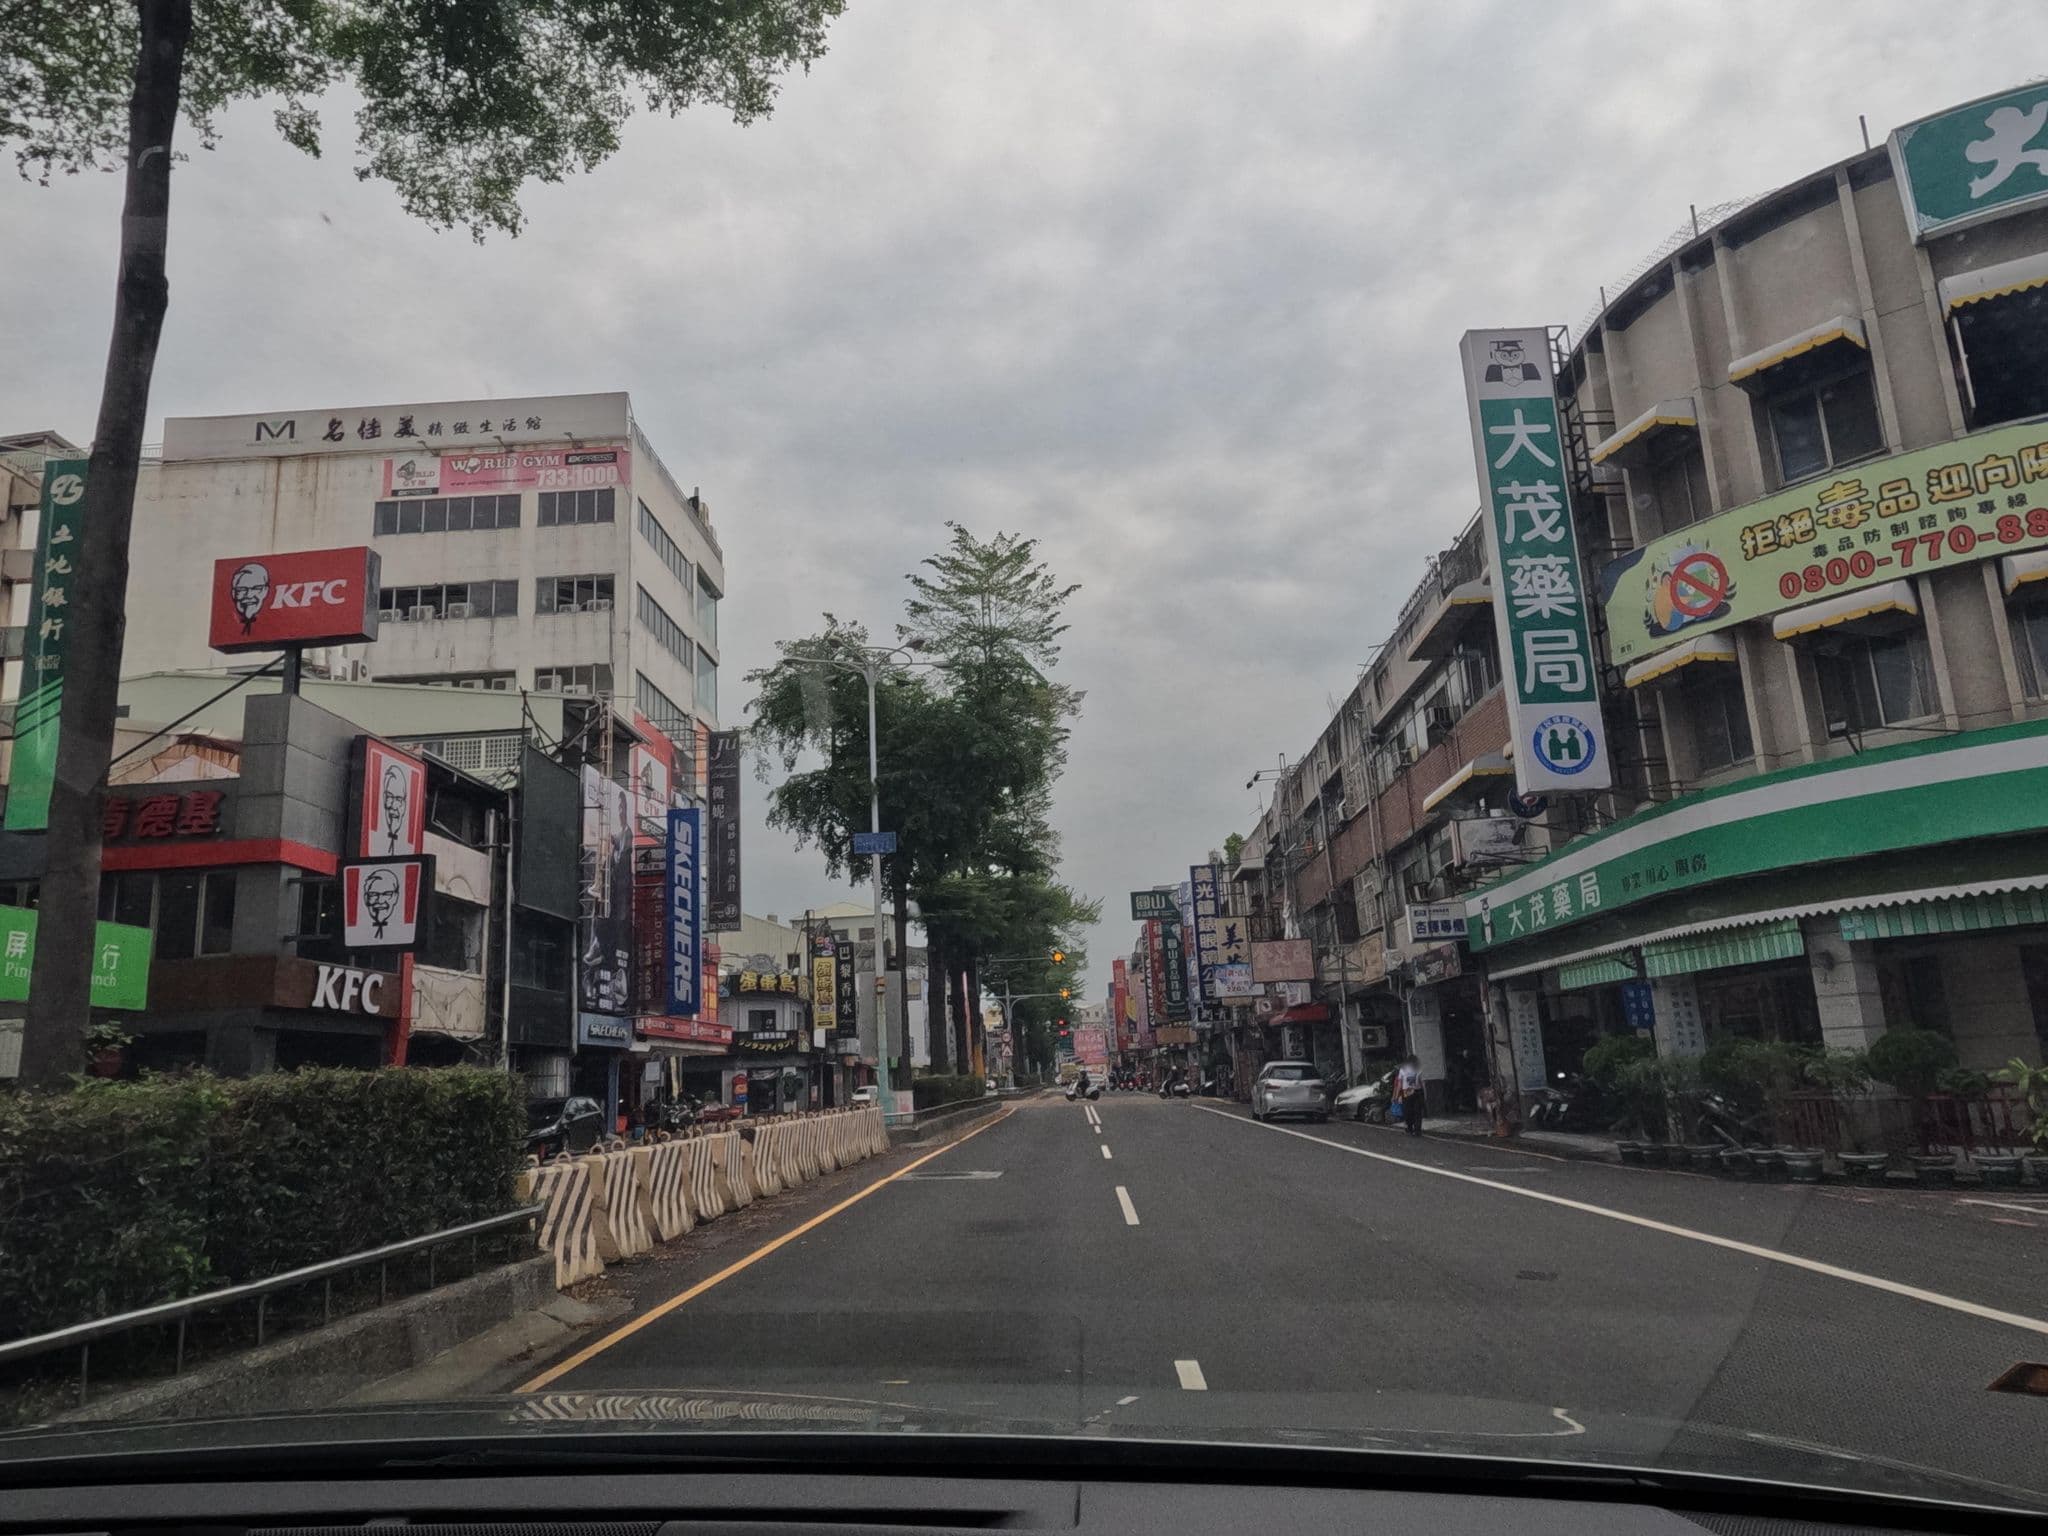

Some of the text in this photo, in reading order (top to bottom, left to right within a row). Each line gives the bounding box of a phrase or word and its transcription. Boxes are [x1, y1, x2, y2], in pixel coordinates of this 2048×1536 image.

[523, 455, 560, 467] GYM
[537, 466, 618, 487] 733-1000
[1489, 408, 1587, 695] 大茂藥局
[40, 524, 75, 642] 土地銀行
[270, 579, 348, 610] KFC
[674, 819, 693, 1005] SKECHERS
[1508, 870, 1601, 936] 大茂藥局
[5, 930, 121, 970] 屏 行
[312, 966, 384, 1014] KFC
[838, 945, 853, 1016] 巴黎香水
